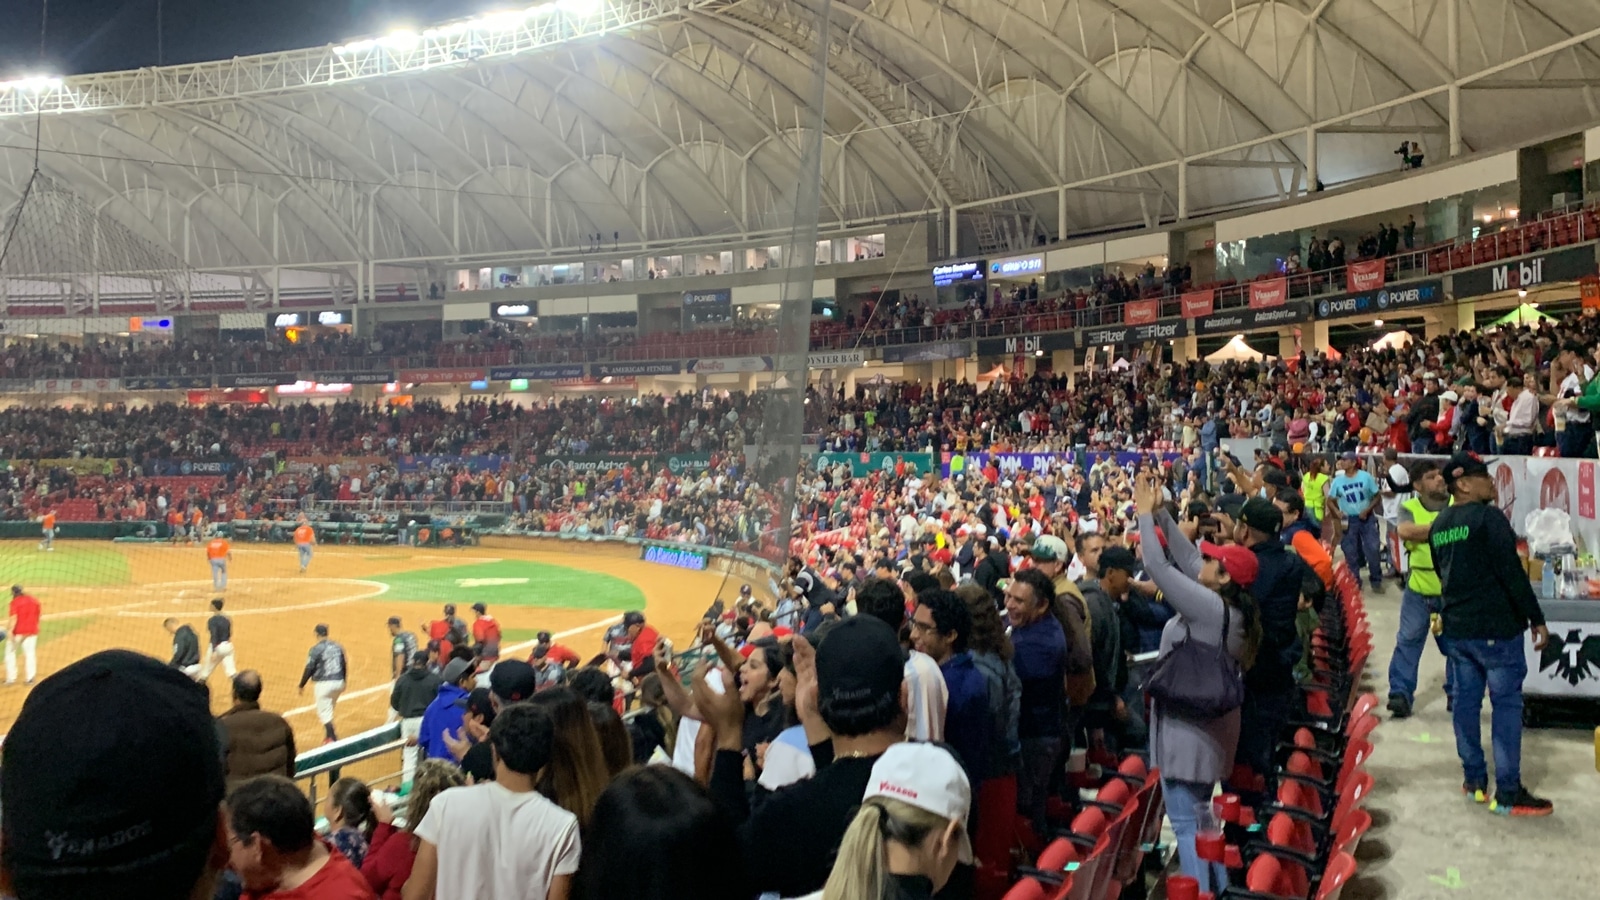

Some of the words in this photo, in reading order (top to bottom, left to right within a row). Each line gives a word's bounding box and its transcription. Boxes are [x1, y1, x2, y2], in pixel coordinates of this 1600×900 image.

[1492, 258, 1543, 291] Mobil
[1100, 329, 1127, 343] Fitzer
[1148, 323, 1177, 338] Fitzer
[1005, 335, 1040, 353] Mobil
[611, 365, 645, 374] AMERICAN
[646, 364, 673, 373] FITNESS
[568, 460, 596, 471] Banco
